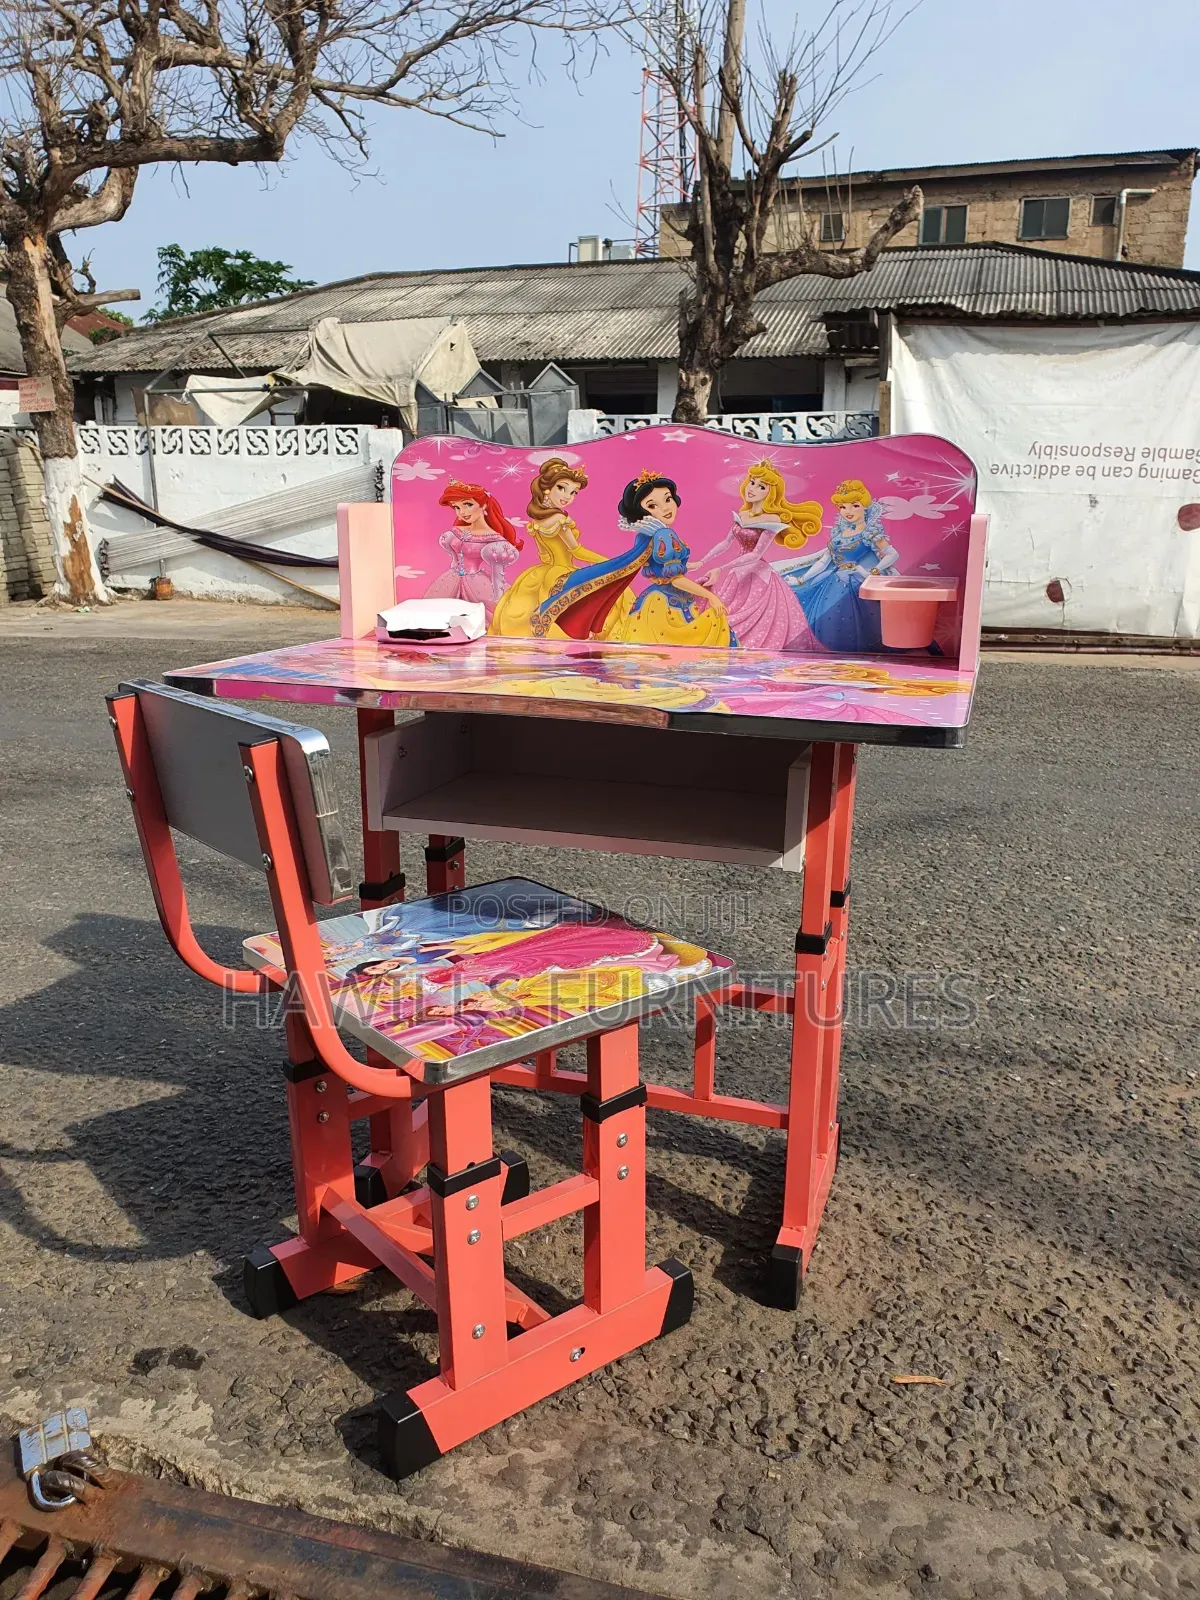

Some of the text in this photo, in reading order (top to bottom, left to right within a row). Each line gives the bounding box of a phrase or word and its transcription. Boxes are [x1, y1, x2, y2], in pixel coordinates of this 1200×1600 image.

[1028, 441, 1136, 462] Responsibly
[990, 463, 1071, 479] addictive
[1075, 465, 1096, 480] be
[1101, 466, 1133, 478] can
